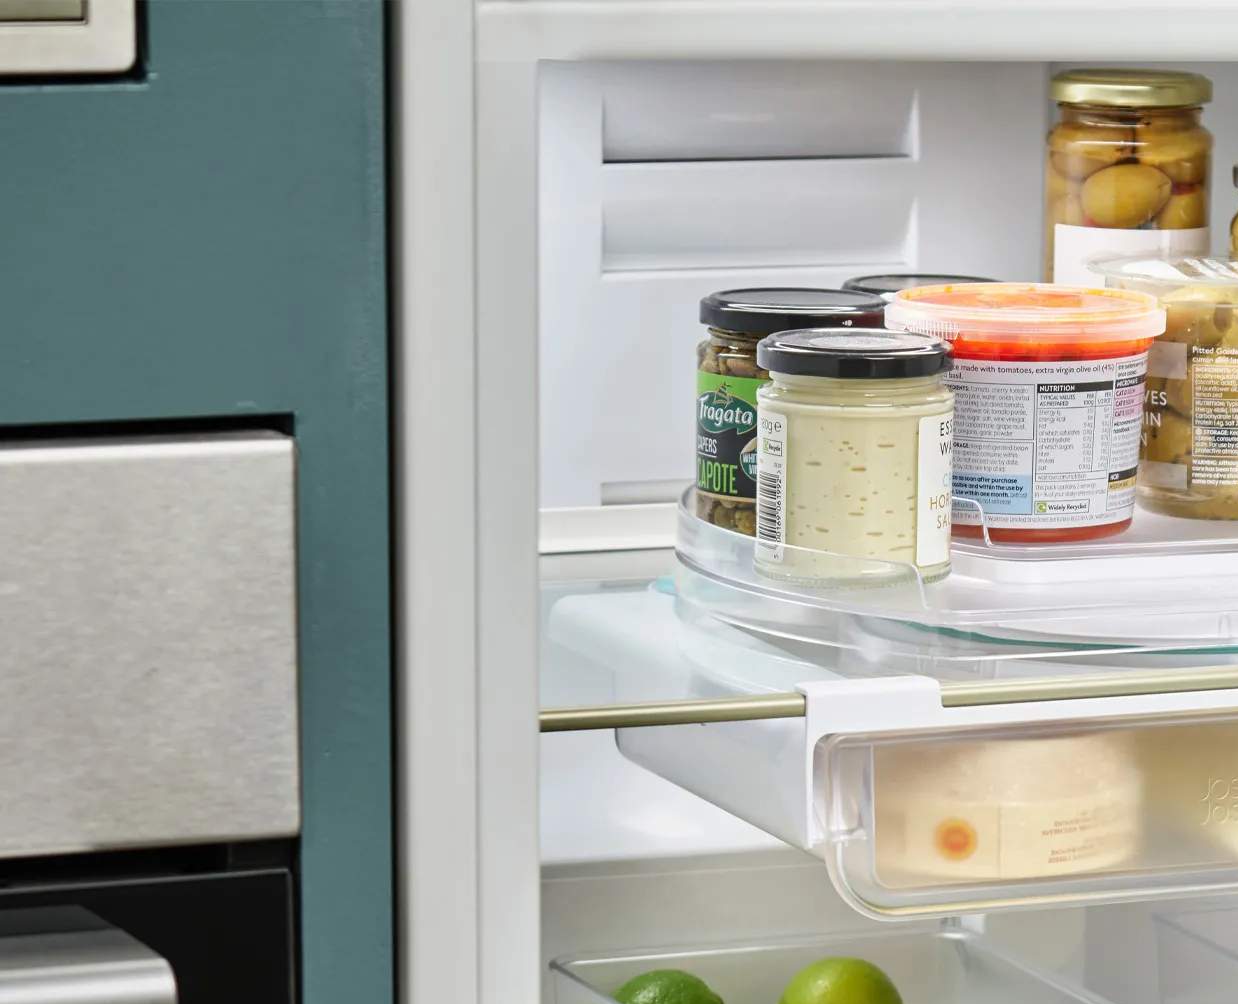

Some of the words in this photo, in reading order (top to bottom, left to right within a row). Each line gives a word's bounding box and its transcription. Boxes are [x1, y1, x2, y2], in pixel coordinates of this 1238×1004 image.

[960, 364, 979, 372] made
[998, 366, 1034, 374] tomatoes,
[1036, 366, 1054, 374] extra
[1056, 366, 1074, 375] virgin
[1076, 365, 1092, 373] olive
[1092, 364, 1100, 372] oil
[1048, 504, 1066, 512] Widely
